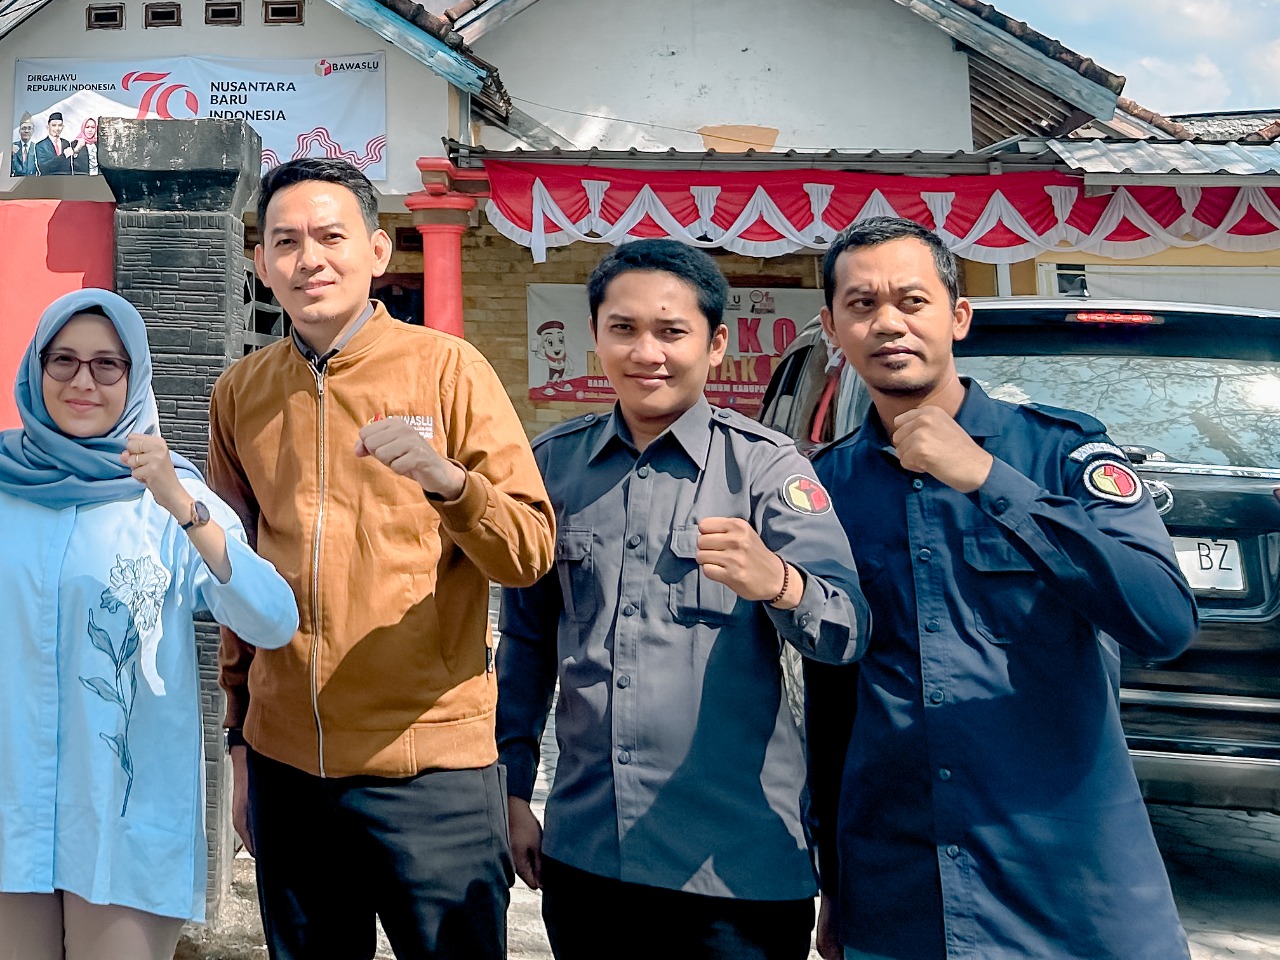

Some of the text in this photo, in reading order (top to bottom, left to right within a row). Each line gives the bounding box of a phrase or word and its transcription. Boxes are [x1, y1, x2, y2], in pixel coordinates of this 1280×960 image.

[332, 61, 379, 71] BAWASLU
[27, 73, 77, 82] DIRGAHAYU
[26, 83, 117, 92] REPUBLIK INDONESIA
[209, 81, 297, 92] NUSANTARA
[209, 94, 248, 105] BARU
[209, 109, 287, 121] INDONESIA
[1197, 542, 1233, 571] BZ
